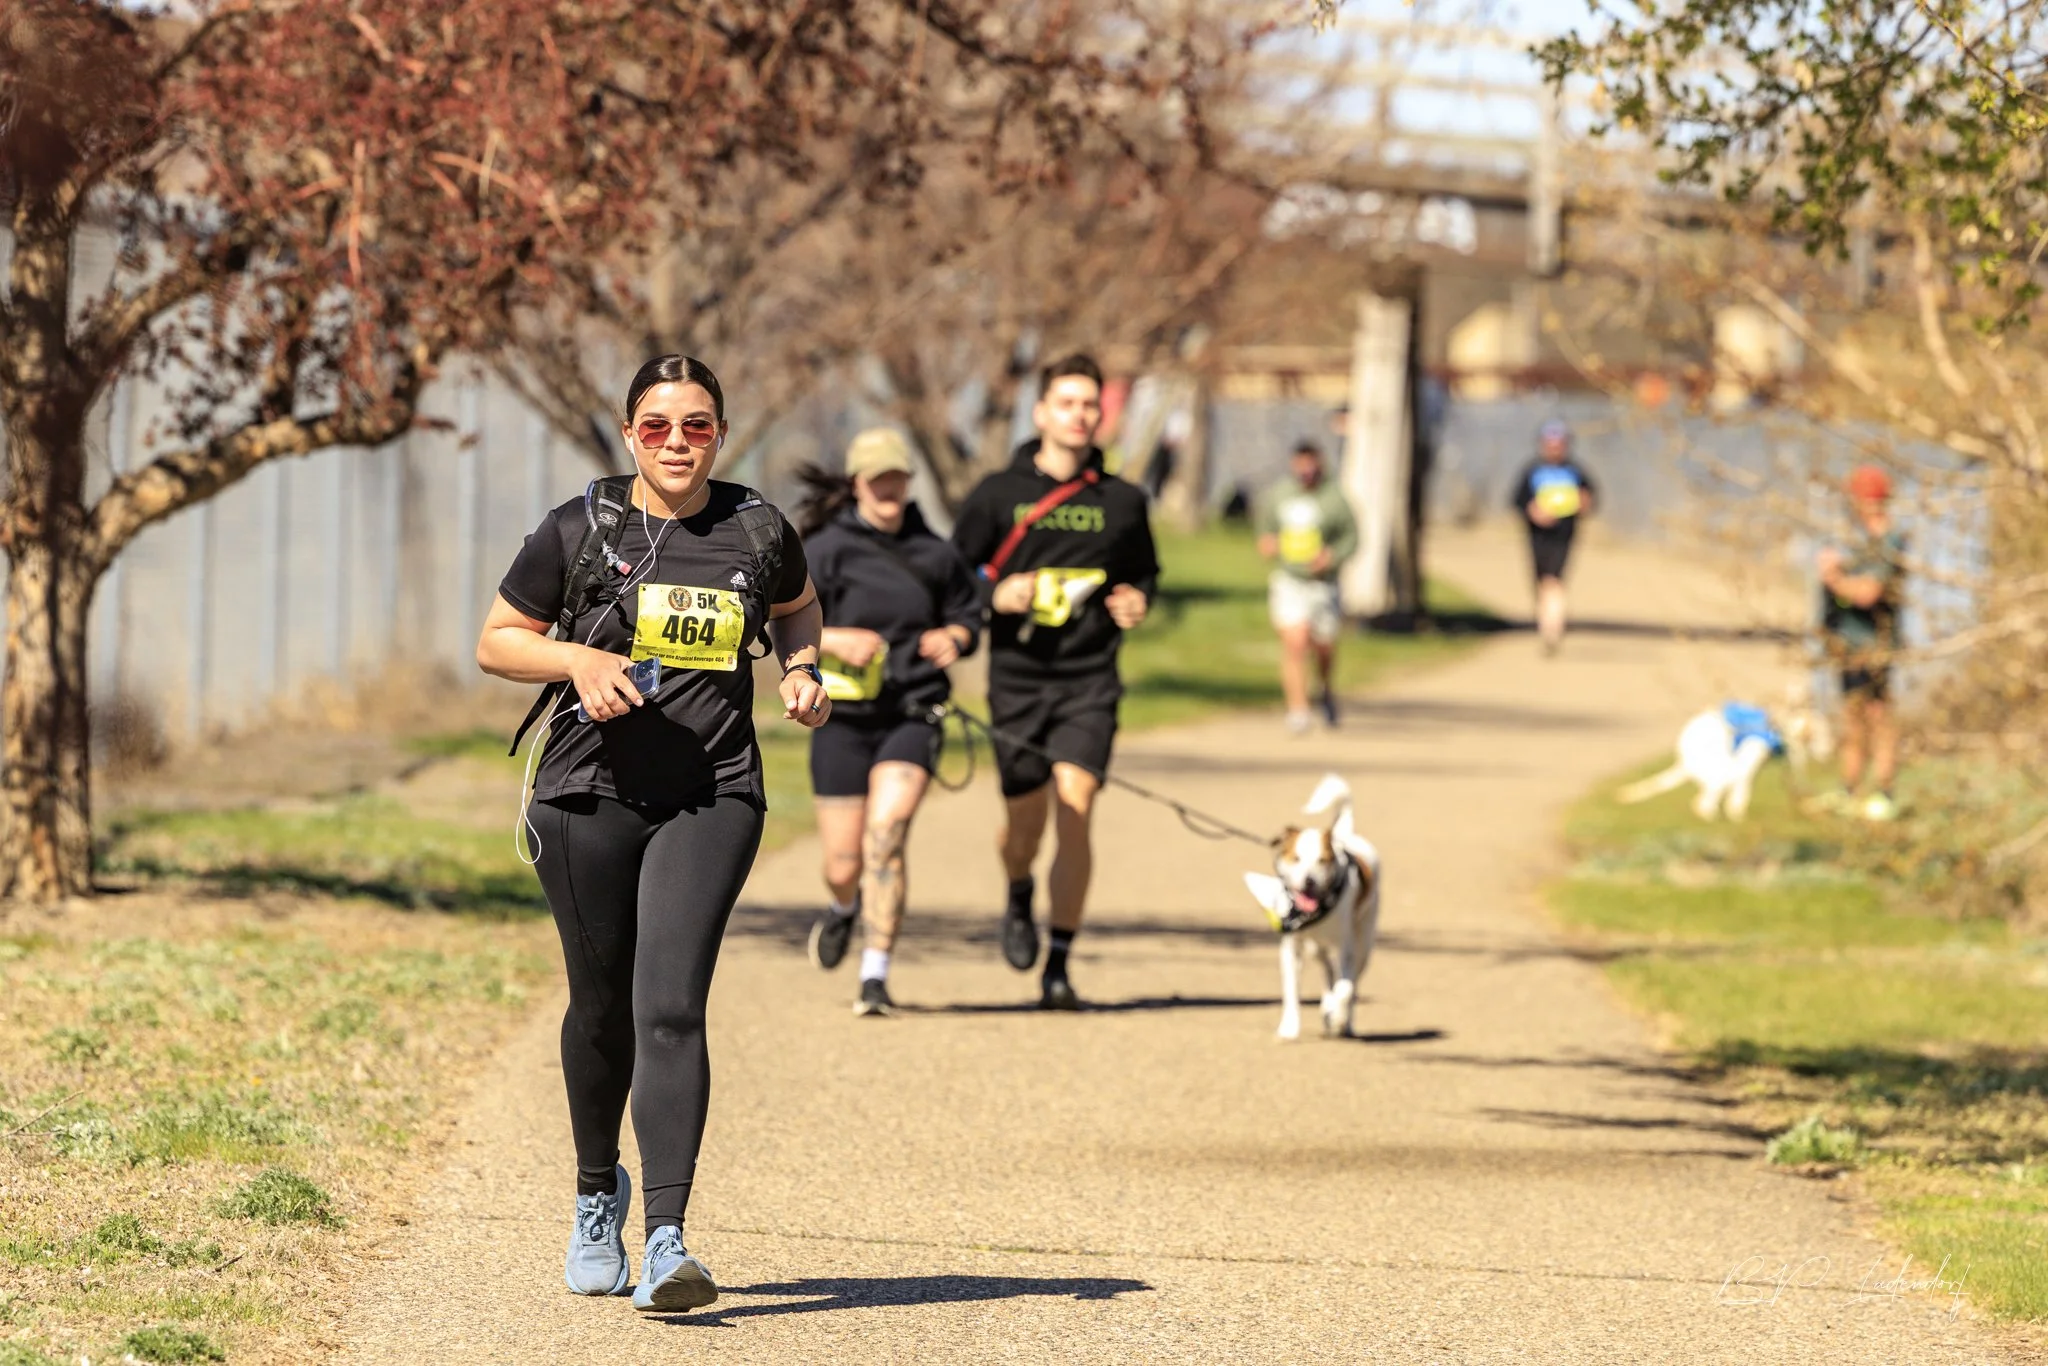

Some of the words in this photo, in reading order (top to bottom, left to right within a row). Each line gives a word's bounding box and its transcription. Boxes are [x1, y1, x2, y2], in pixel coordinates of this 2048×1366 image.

[730, 577, 748, 587] adidas
[697, 592, 721, 613] 5K
[661, 614, 716, 646] 464
